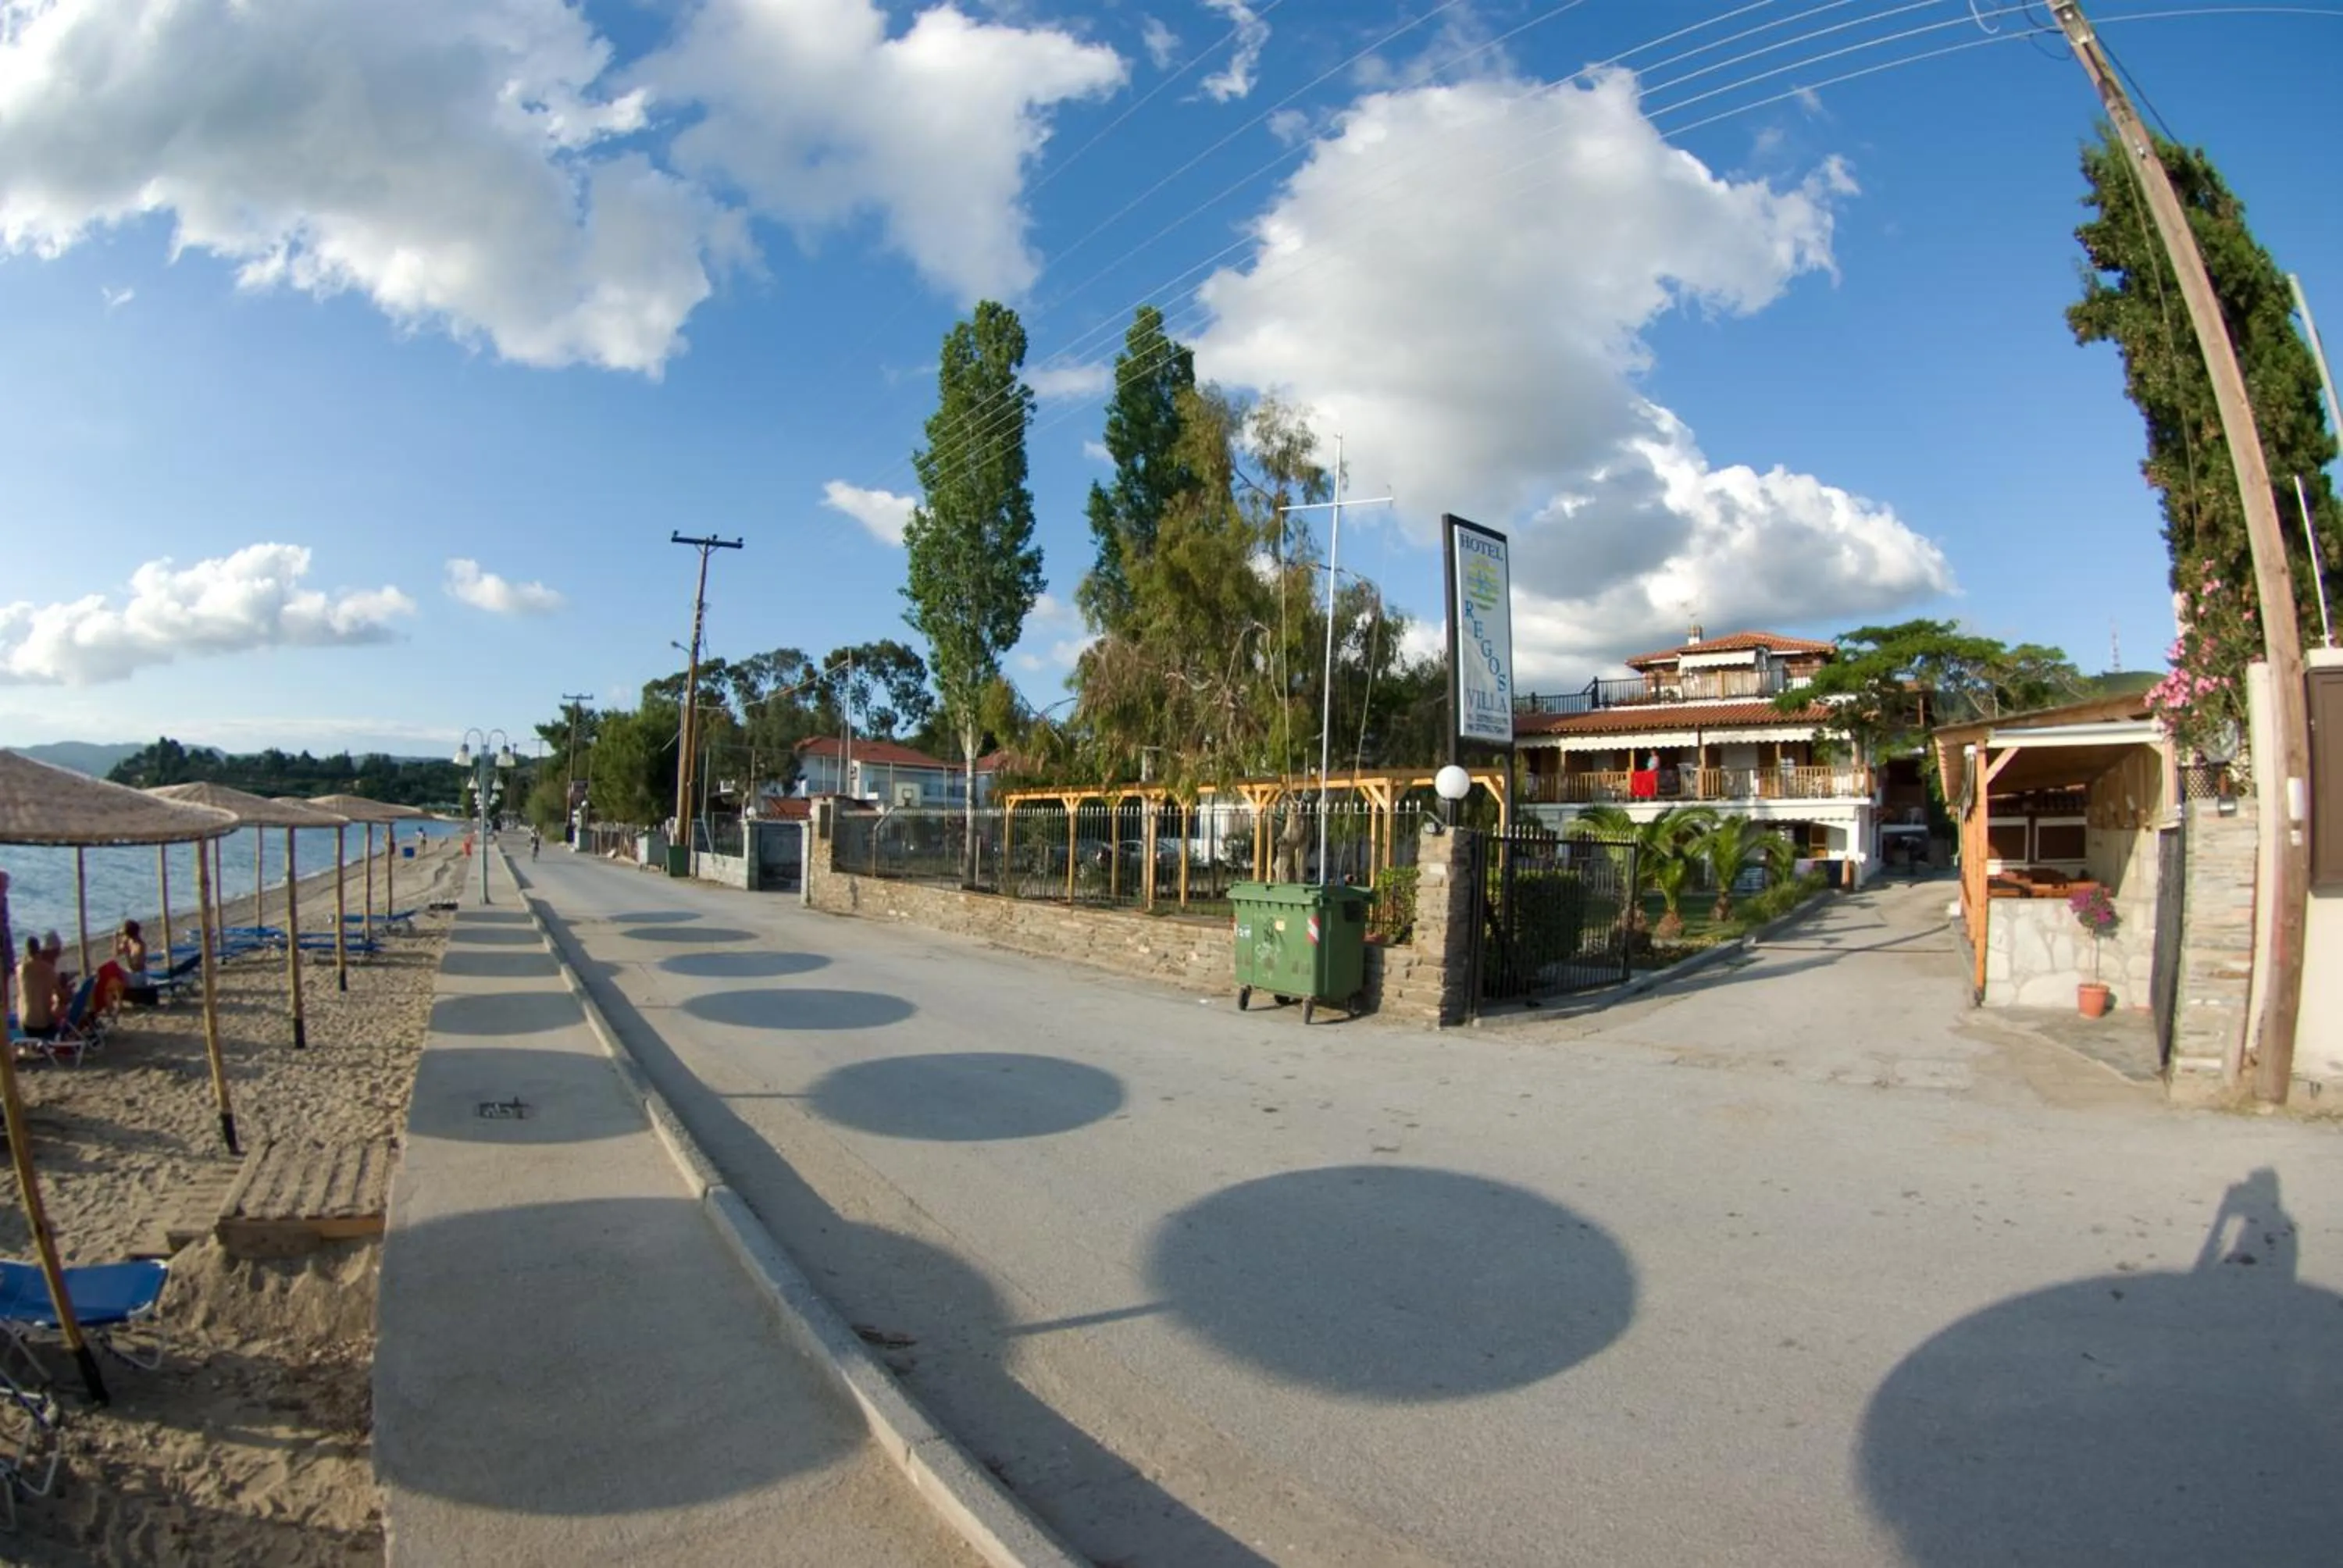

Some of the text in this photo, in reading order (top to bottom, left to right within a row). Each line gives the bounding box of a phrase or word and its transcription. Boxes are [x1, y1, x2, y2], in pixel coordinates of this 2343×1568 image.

[1459, 533, 1503, 561] HOTEL
[1464, 600, 1507, 691] REGOS
[1467, 687, 1508, 713] VILLA
